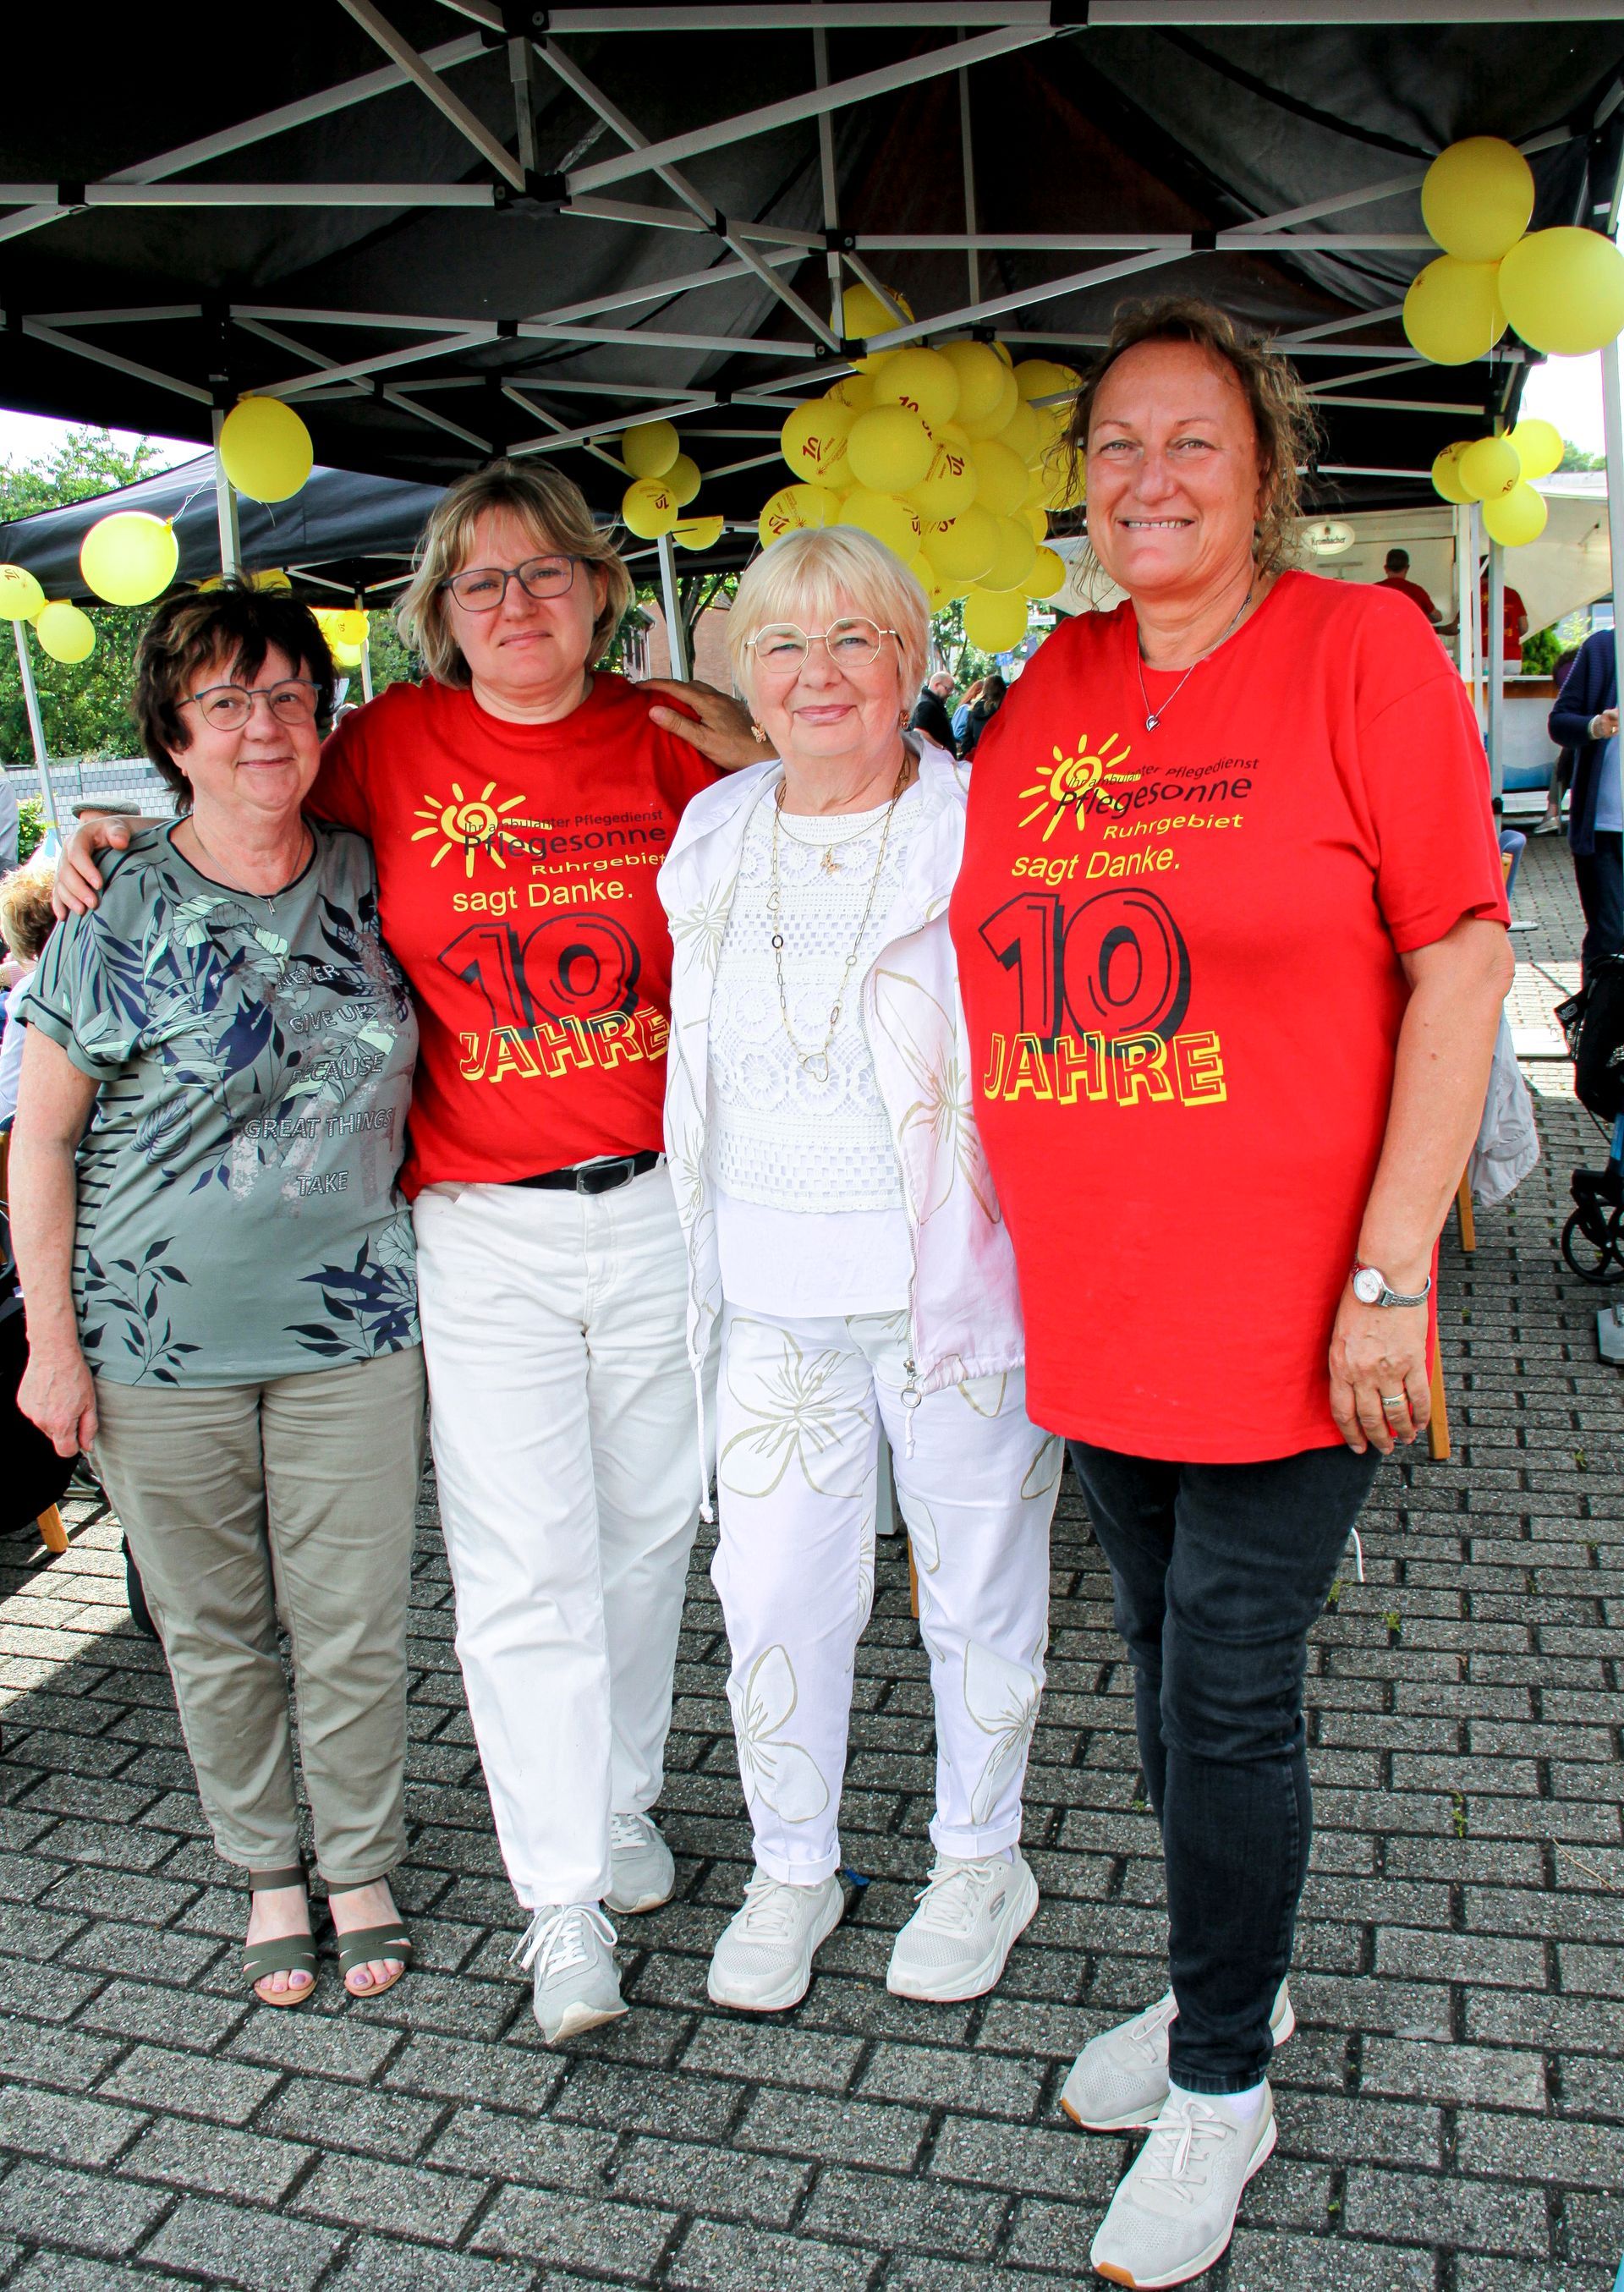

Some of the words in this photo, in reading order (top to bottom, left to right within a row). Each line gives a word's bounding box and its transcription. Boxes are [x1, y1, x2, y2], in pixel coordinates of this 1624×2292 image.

[802, 436, 822, 463] 10
[946, 454, 965, 476] 10
[654, 494, 669, 509] 10
[769, 513, 790, 535] 10
[1166, 757, 1259, 779] Pflegedienst
[1054, 778, 1253, 820] Pflegesonne
[575, 809, 663, 828] Pflegedienst
[1103, 814, 1244, 841] Ruhrgebiet
[463, 826, 667, 862] Pflegesonne
[532, 853, 667, 875] Ruhrgebiet
[1012, 853, 1080, 886] sagt
[1085, 846, 1181, 880] Danke.
[453, 885, 518, 917] sagt
[528, 878, 634, 907] Danke.
[277, 962, 340, 990] NEVER
[437, 912, 641, 1044] 10
[978, 887, 1191, 1058] 10
[288, 1010, 337, 1034] GIVE
[337, 1003, 369, 1022] UP
[459, 1006, 670, 1083] JAHRE
[290, 1051, 386, 1084] BECAUSE
[984, 1030, 1227, 1107] JAHRE
[244, 1118, 321, 1139] GREAT
[326, 1107, 393, 1138] THINGS
[297, 1171, 349, 1198] TAKE
